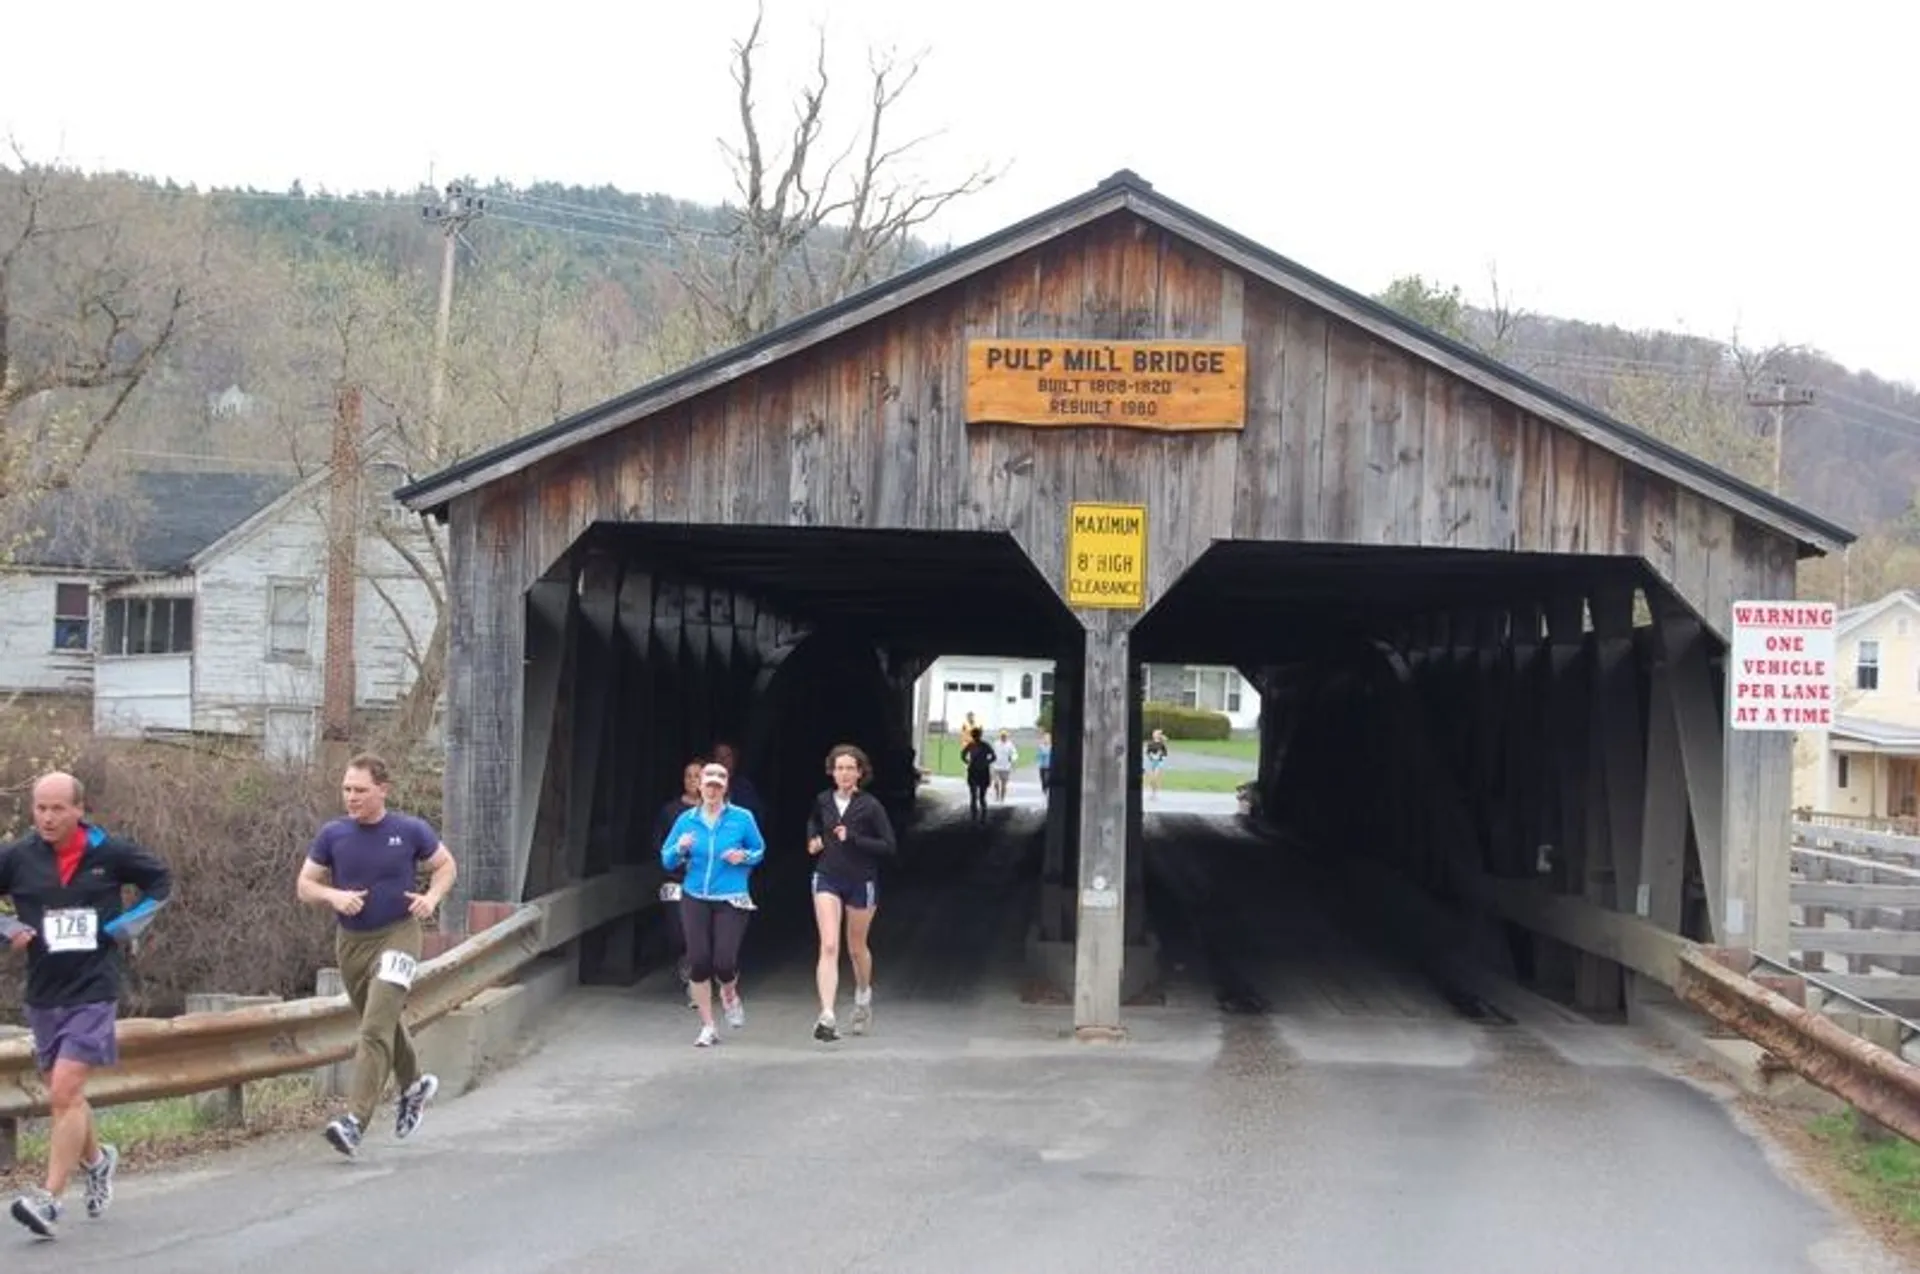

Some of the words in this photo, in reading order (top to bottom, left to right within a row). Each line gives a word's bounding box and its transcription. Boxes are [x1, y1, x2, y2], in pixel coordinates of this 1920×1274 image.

[987, 348, 1052, 371] PULP
[1063, 349, 1122, 372] MILL
[1133, 350, 1225, 373] BRIDGE
[1037, 378, 1081, 394] BUILT
[1050, 399, 1113, 415] REBUILT
[1075, 515, 1139, 536] MAXIMUM
[1097, 553, 1133, 573] HIGH
[1070, 578, 1139, 595] CLEARANCE
[1736, 607, 1833, 625] WARNING
[1766, 636, 1804, 652] ONE
[1744, 660, 1825, 676] VEHICLE
[1737, 683, 1775, 698] PER
[1781, 684, 1830, 700] LANE
[1737, 707, 1759, 722] AT
[1764, 707, 1776, 722] A
[1782, 708, 1830, 724] TIME
